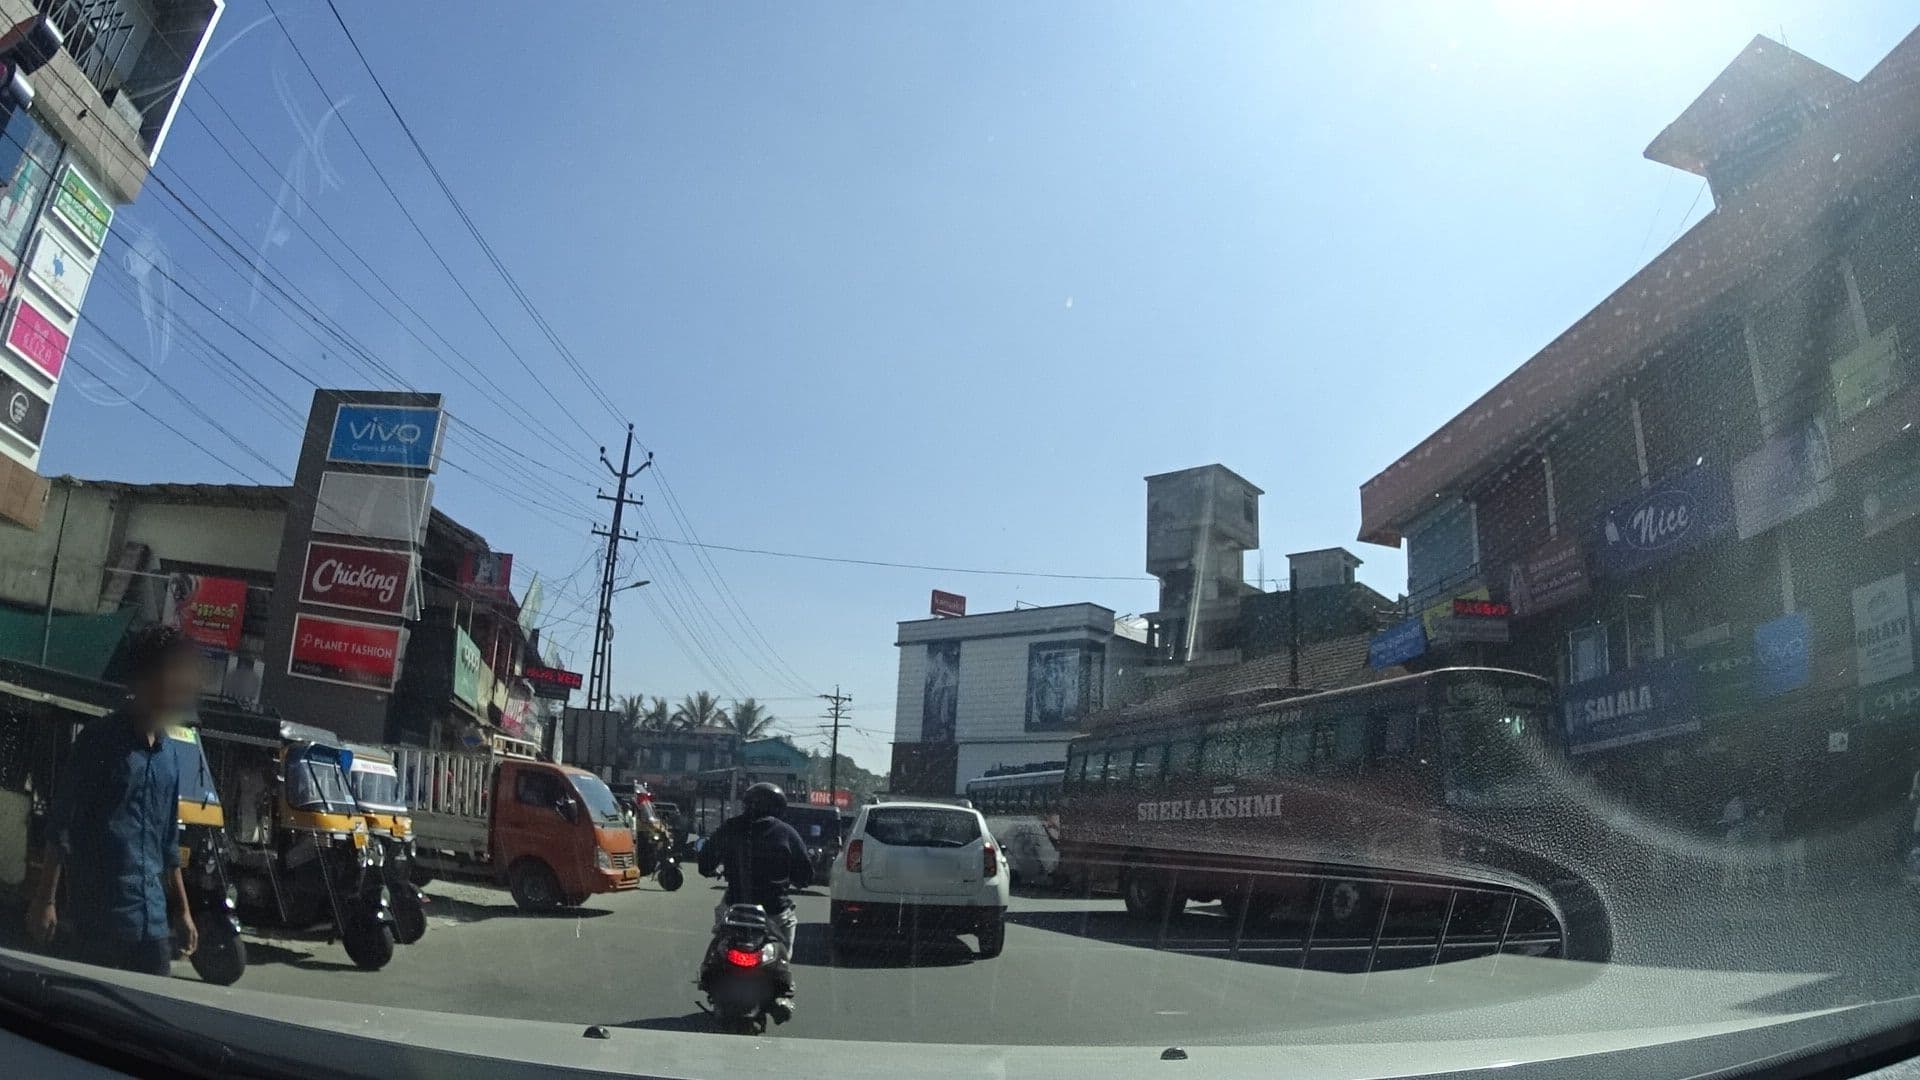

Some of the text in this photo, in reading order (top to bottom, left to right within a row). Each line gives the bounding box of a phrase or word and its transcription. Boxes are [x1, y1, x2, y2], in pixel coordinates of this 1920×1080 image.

[349, 416, 420, 443] vivo
[1632, 504, 1689, 546] Nice
[312, 559, 398, 602] Chicking
[314, 638, 349, 652] PLANET
[351, 643, 392, 659] FASHION
[1585, 685, 1653, 724] SALALA
[1137, 794, 1283, 821] SREELAKSHMI
